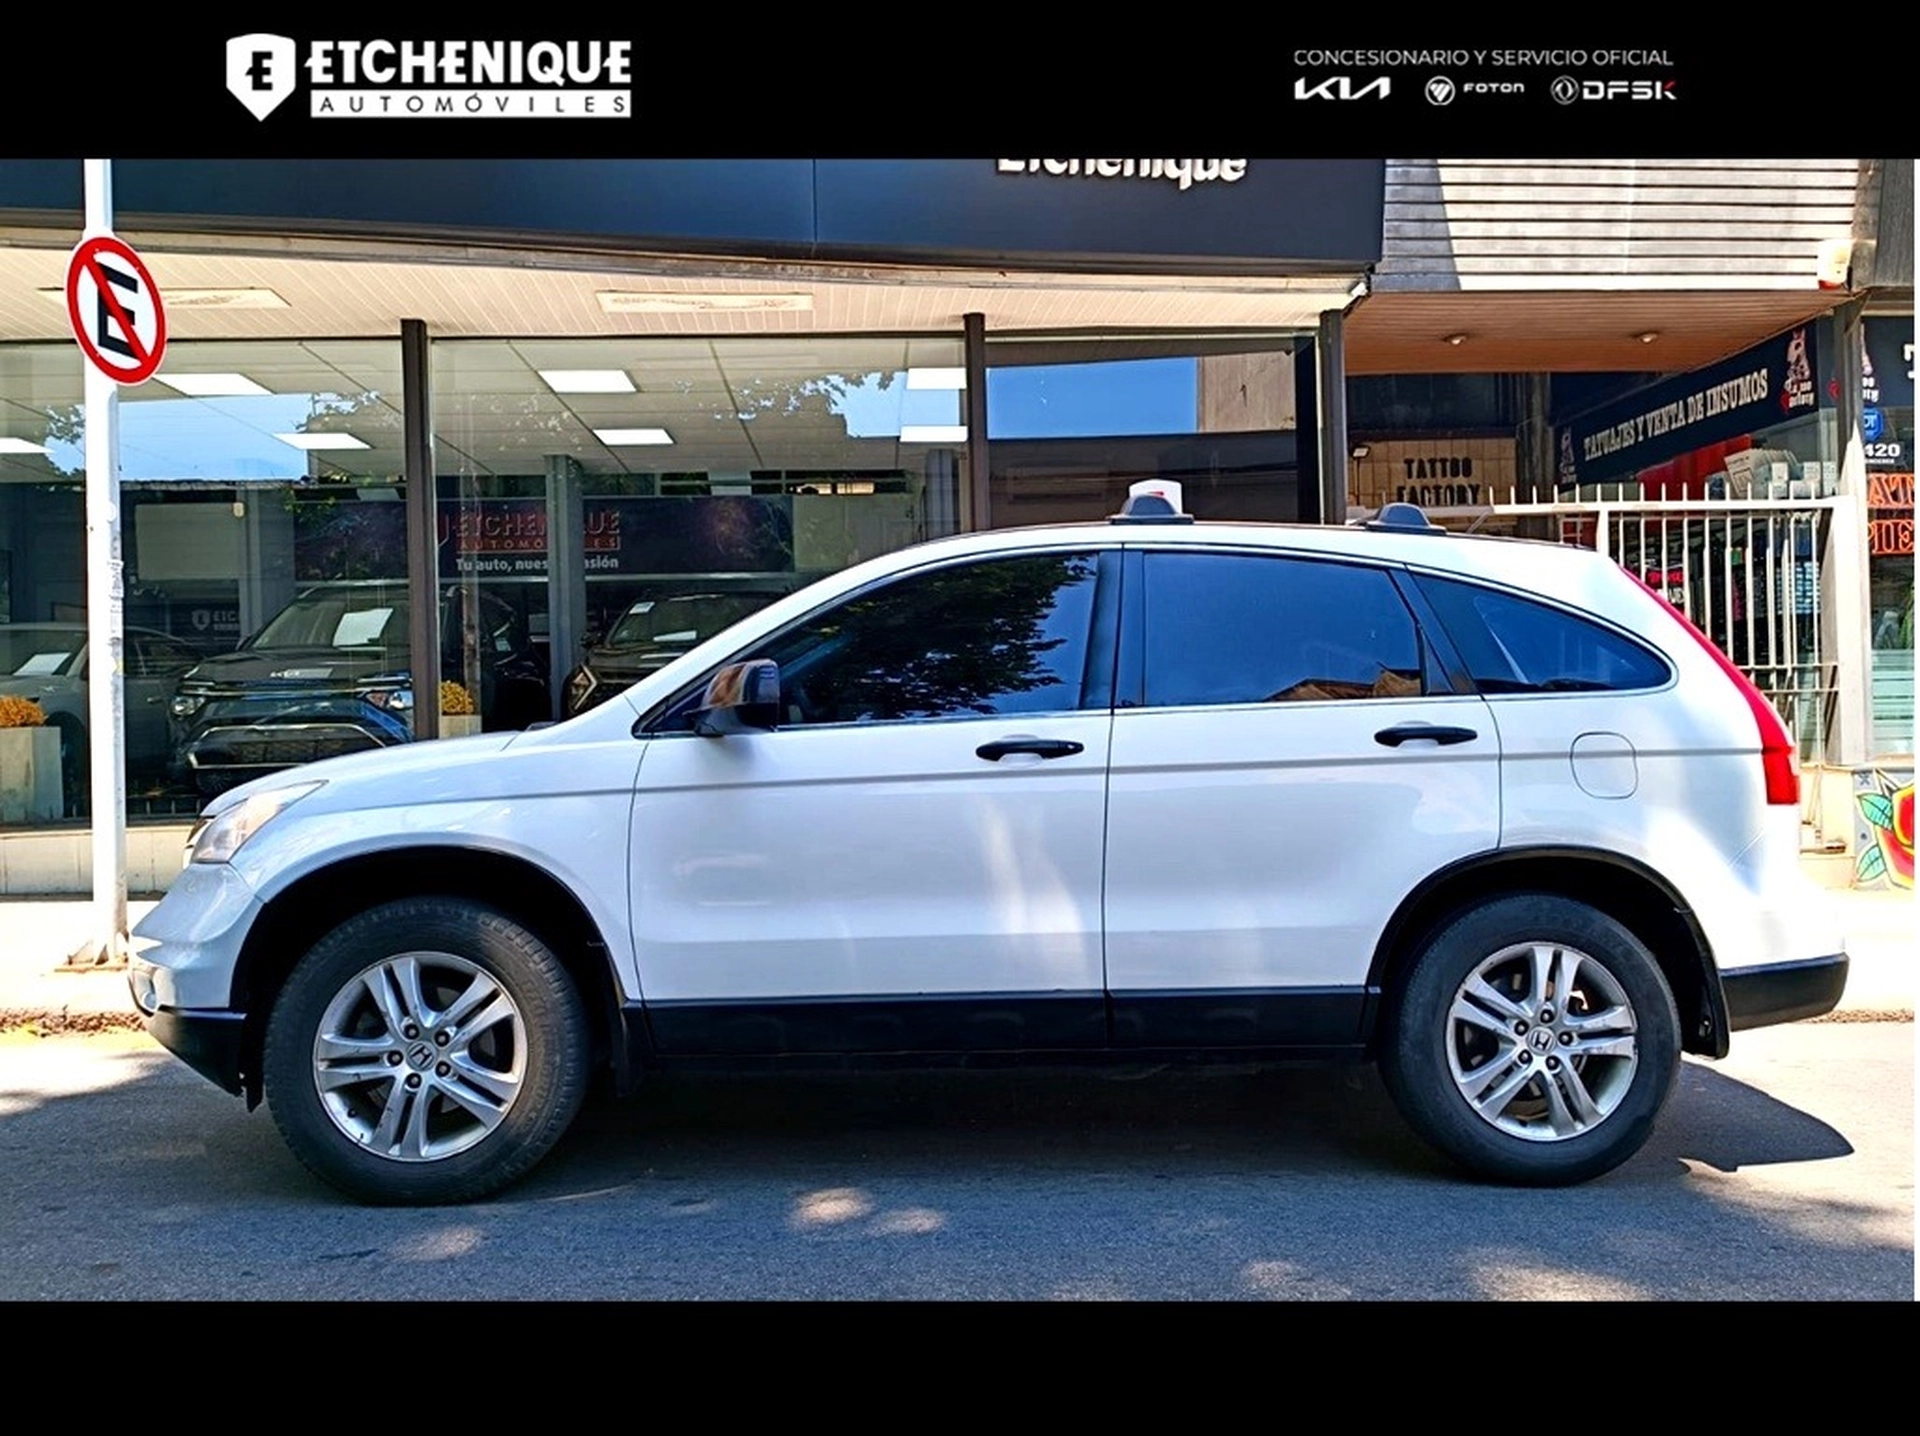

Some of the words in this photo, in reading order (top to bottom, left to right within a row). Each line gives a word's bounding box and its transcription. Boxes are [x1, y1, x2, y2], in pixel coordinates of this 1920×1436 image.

[1583, 419, 1635, 462] TATUAJES
[1635, 414, 1645, 442] Y
[1643, 401, 1686, 438] VENTA
[1687, 393, 1705, 424] DE
[1706, 368, 1769, 417] INSUMOS
[1403, 457, 1472, 479] TATTOO
[1396, 483, 1480, 506] FACTORY
[455, 558, 473, 571] Tu
[476, 558, 512, 572] auto,
[516, 558, 548, 570] nues
